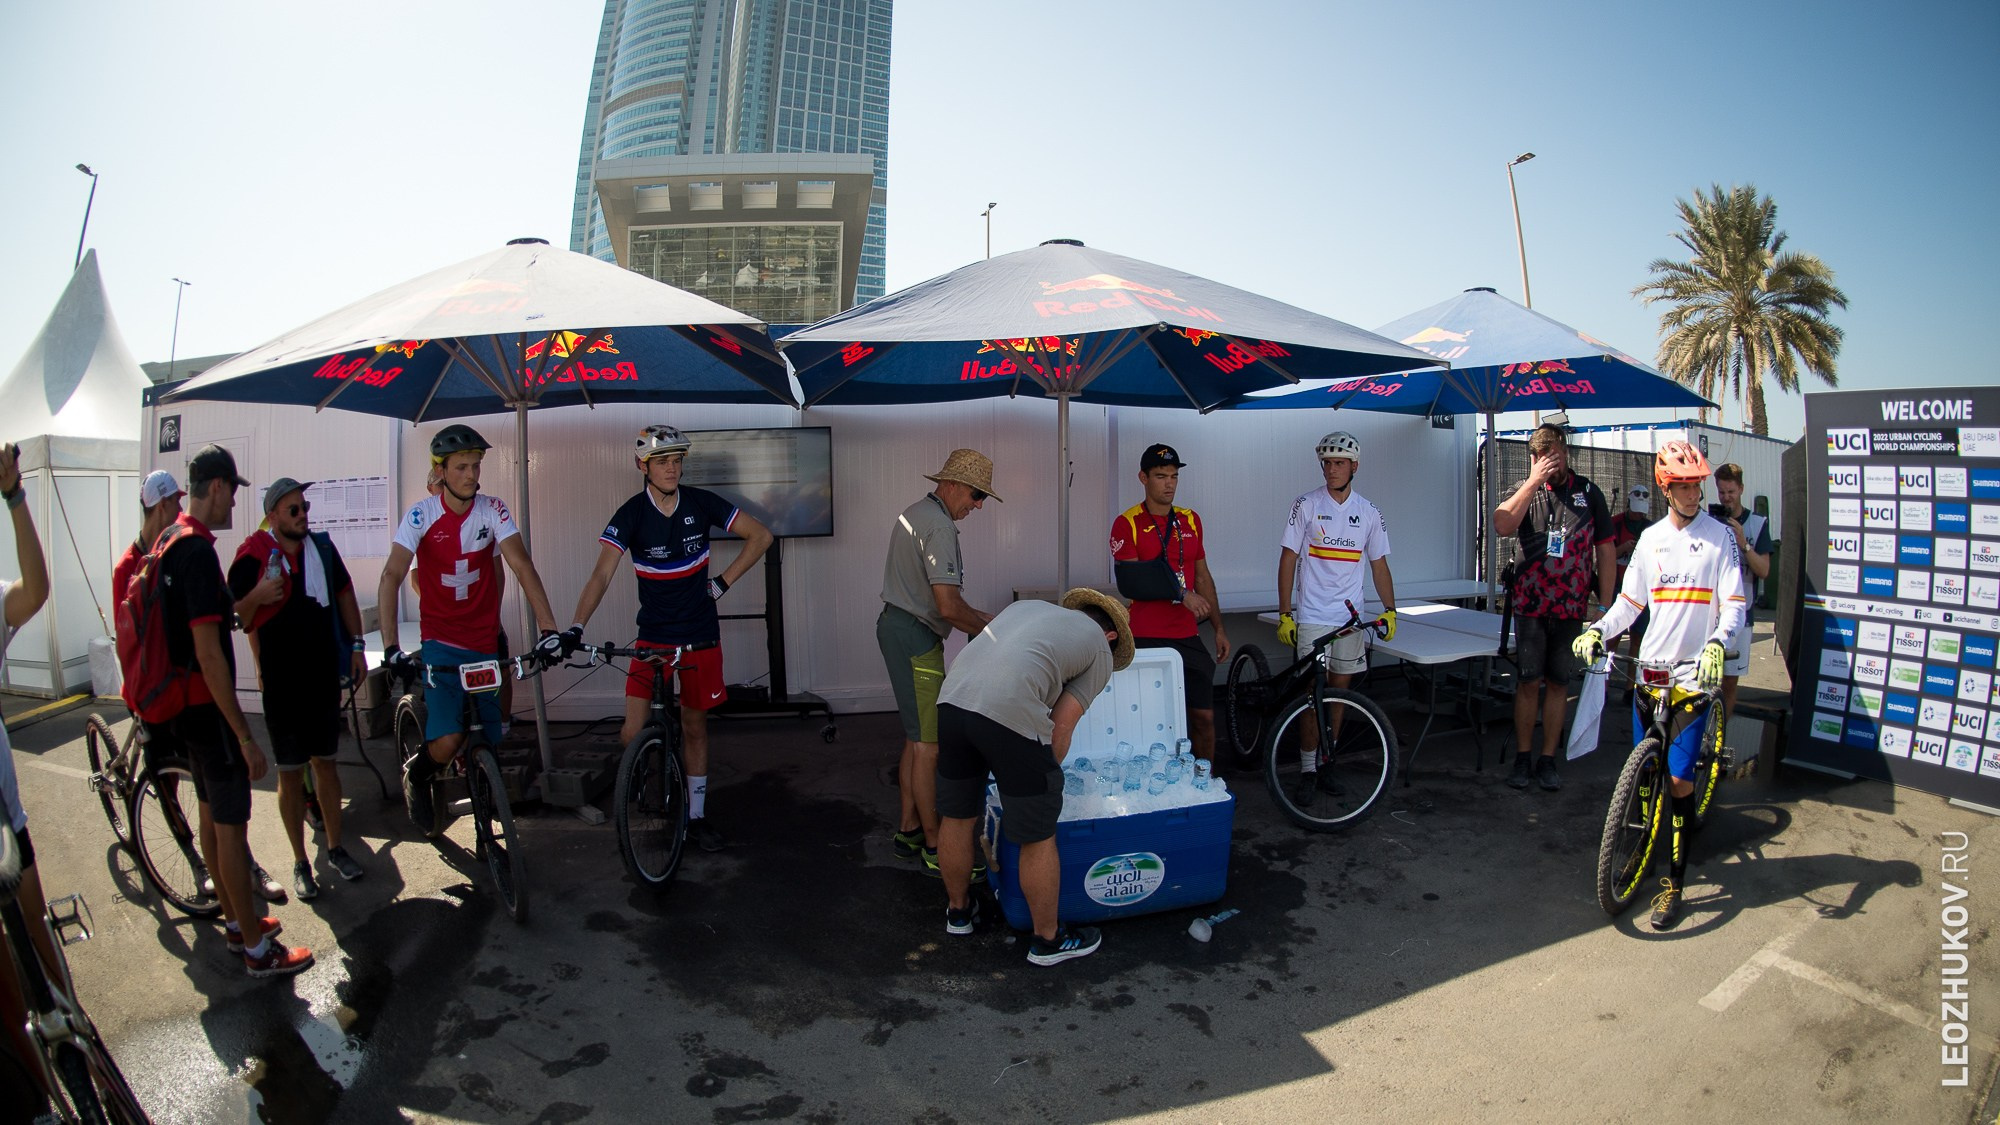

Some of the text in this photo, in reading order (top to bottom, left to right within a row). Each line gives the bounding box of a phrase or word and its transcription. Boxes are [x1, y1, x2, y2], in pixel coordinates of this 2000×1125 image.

[1033, 292, 1225, 323] Red Bull
[1881, 399, 1973, 421] WELCOME
[1834, 433, 1867, 451] UCI
[1873, 432, 1942, 441] 2022 URBAN CYCLING
[1963, 433, 1997, 441] ABU DHABI
[1873, 442, 1956, 451] WORLD CHAMPIONSHIPS
[1963, 444, 1976, 452] UAE
[1834, 473, 1858, 486] UCI
[1905, 474, 1929, 488] UCI
[1972, 479, 2000, 488] SHIMANO
[1288, 496, 1307, 527] Cofidis
[1869, 507, 1893, 521] UCI
[1937, 513, 1966, 522] SHIMANO
[1322, 536, 1356, 548] Cofidis
[1834, 539, 1857, 552] UCI
[1901, 546, 1929, 555] SHIMANO
[1972, 553, 1999, 563] TISSOT
[1660, 573, 1695, 584] Cofdis
[1864, 577, 1893, 586] SHIMANO
[1935, 585, 1963, 595] TISSOT
[1838, 602, 1856, 610] uci.org
[1875, 607, 1904, 617] uci_cycling
[1954, 616, 1981, 624] ucichannel
[1825, 626, 1854, 636] SHIMANO
[1895, 637, 1923, 648] TISSOT
[1965, 645, 1993, 656] SHIMANO
[1857, 666, 1884, 676] TISSOT
[467, 671, 495, 687] 202
[1926, 675, 1954, 686] SHIMANO
[1818, 691, 1845, 703] TISSOT
[1887, 702, 1915, 714] SHIMANO
[1959, 713, 1982, 730] UCI
[1847, 728, 1875, 740] SHIMANO
[1919, 740, 1943, 757] UCI
[1983, 758, 2000, 770] TISS
[1104, 885, 1118, 898] al
[1120, 883, 1144, 896] ain
